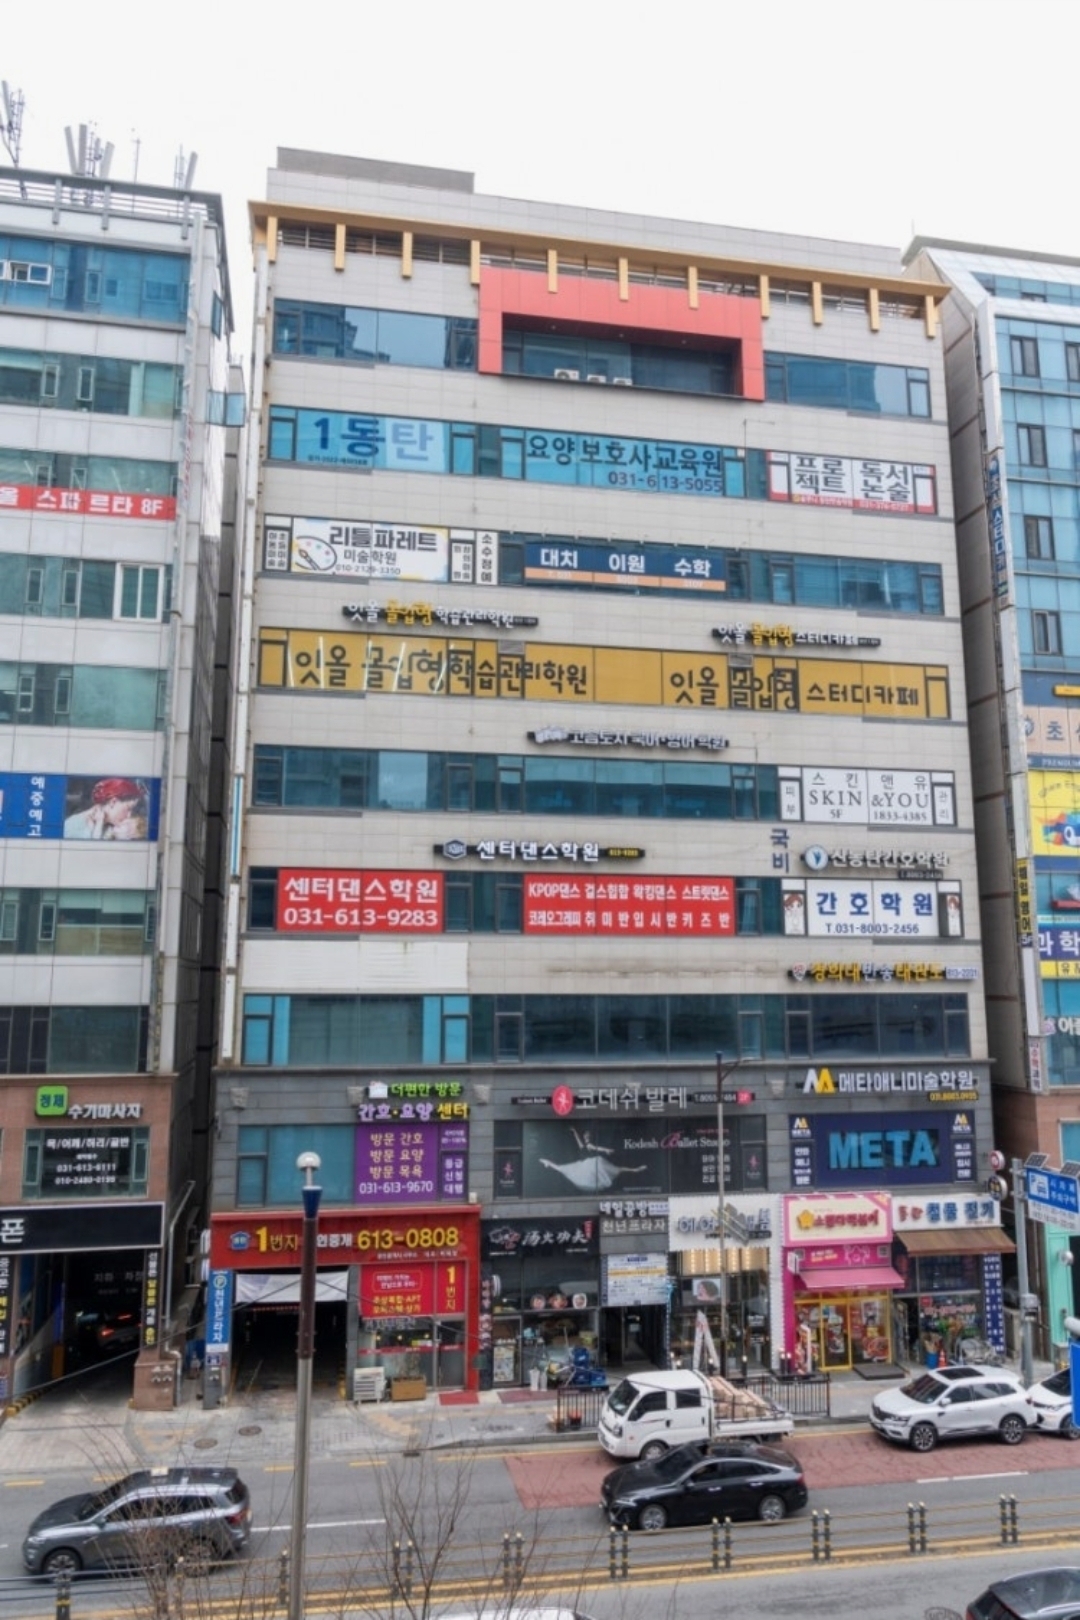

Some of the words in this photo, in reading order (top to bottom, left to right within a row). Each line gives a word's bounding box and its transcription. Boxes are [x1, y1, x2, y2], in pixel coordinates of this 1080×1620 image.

[527, 435, 722, 478] 요양보호사교육원
[607, 470, 723, 493] 031-613-5055
[343, 549, 397, 566] 미술학원
[481, 532, 493, 583] 소수정예
[540, 549, 578, 569] 대치
[608, 554, 646, 573] 이원
[674, 558, 712, 577] 수학
[347, 601, 381, 623] 잇올
[719, 621, 747, 644] 잇올
[296, 644, 351, 687] 잇올
[449, 655, 587, 696] 학습관리학원
[670, 666, 720, 706] 잇올
[806, 682, 920, 707] 스터디카페
[808, 790, 863, 807] SKIN
[871, 792, 930, 809] &YOU
[829, 808, 844, 820] 5F
[476, 840, 599, 862] 센터댄스학원
[769, 828, 791, 874] 국비
[284, 877, 439, 903] 센터댄스학원
[528, 883, 582, 899] KPOP댄스
[585, 883, 630, 900] 걸스힙합
[682, 885, 730, 901] 스트릿댄스
[284, 907, 439, 927] 031-613-9283
[825, 923, 920, 935] T.031-8003-2456
[839, 1070, 974, 1093] 메타애니미술학원
[575, 1087, 642, 1111] 코데쉬
[645, 1086, 688, 1112] 발레
[67, 1103, 142, 1119] 수기마사지
[437, 1102, 469, 1120] 센터
[623, 1137, 659, 1150] Kodesh
[828, 1130, 938, 1170] META
[359, 1180, 434, 1195] 031-613-9670
[599, 1200, 649, 1218] 네일공방
[603, 1219, 666, 1234] 천년프라자
[255, 1226, 299, 1253] 1번지
[356, 1226, 460, 1250] 613-0808
[445, 1265, 457, 1311] 1번지
